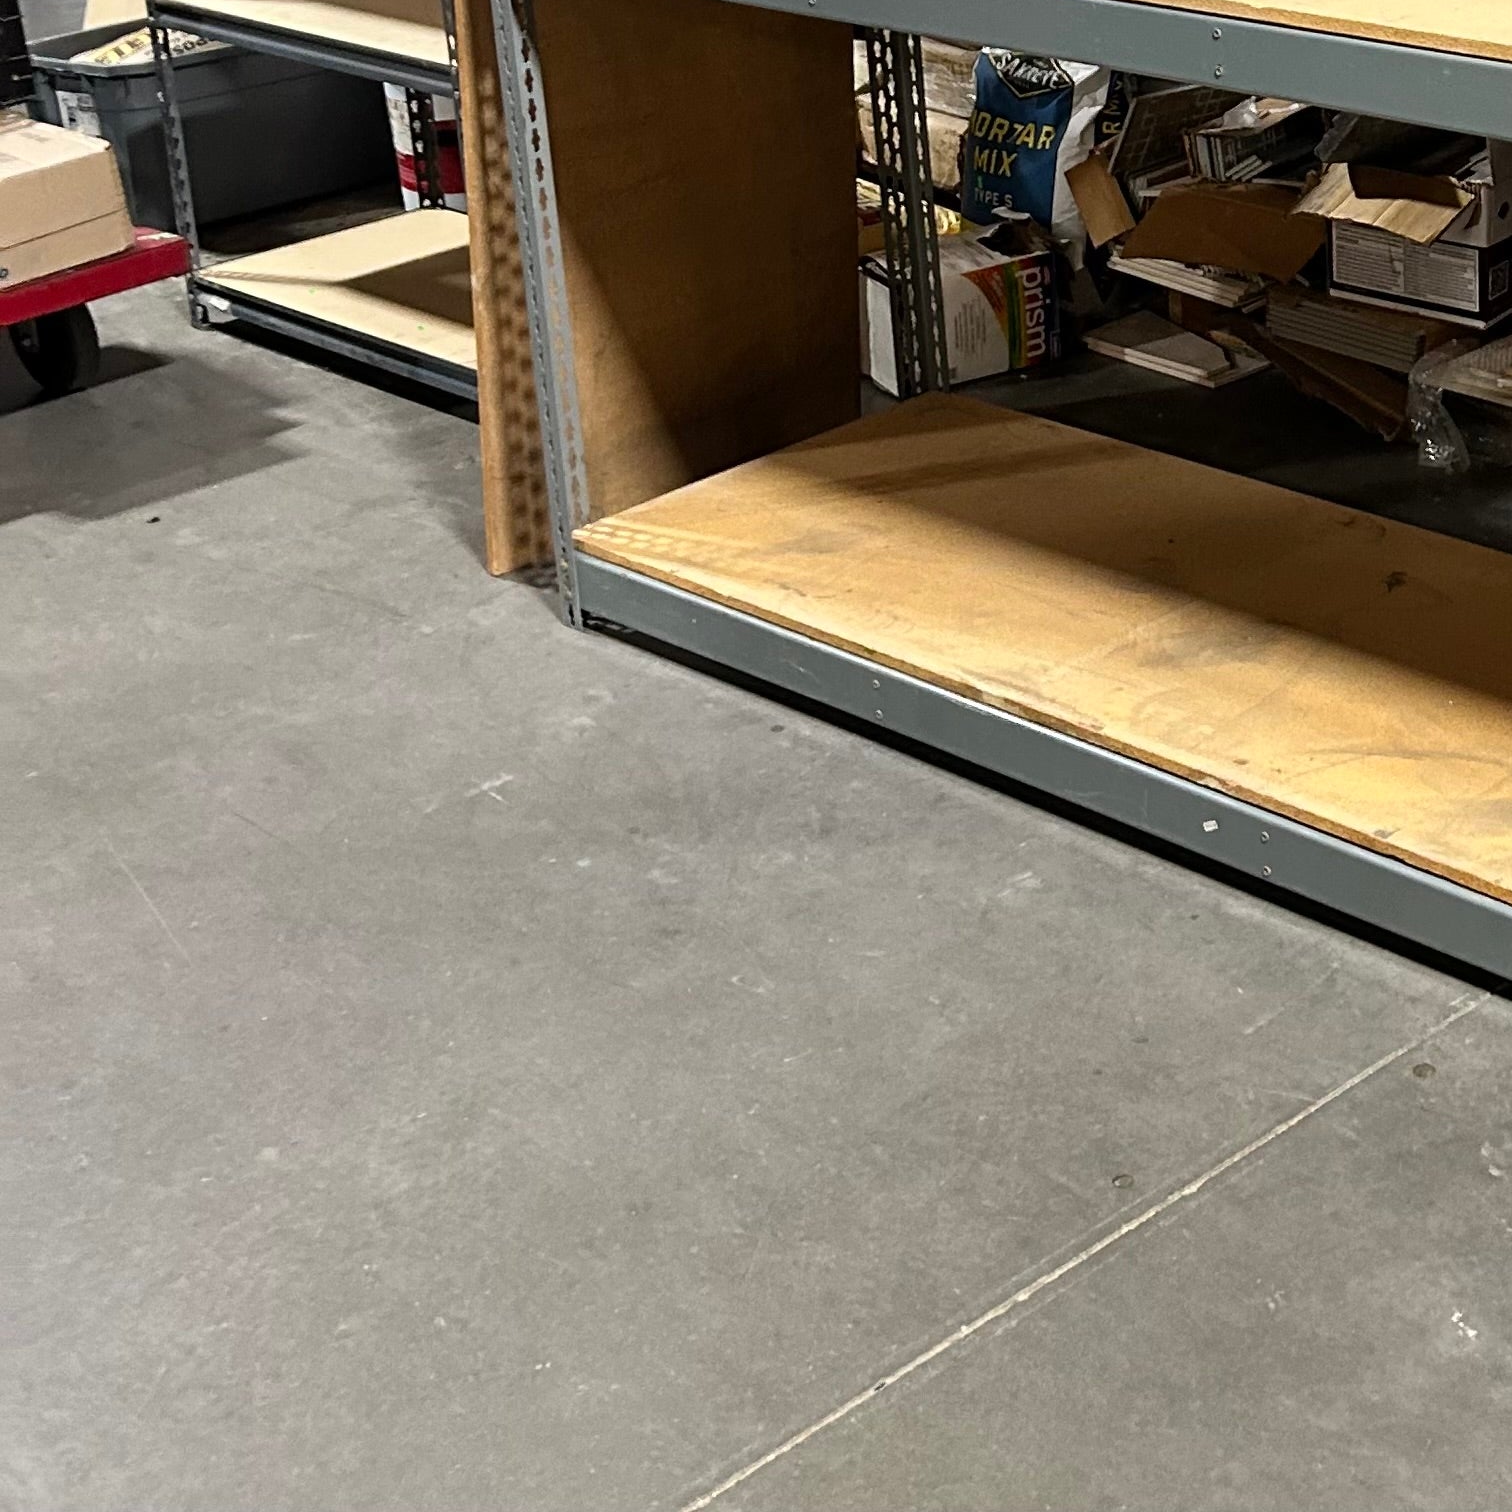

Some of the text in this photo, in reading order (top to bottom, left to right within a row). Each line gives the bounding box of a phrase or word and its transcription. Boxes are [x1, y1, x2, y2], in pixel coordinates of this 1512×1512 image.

[968, 109, 1056, 150] ORTAR
[974, 145, 1018, 177] MIX
[974, 188, 1014, 208] TYPE S
[1014, 266, 1052, 359] prism
